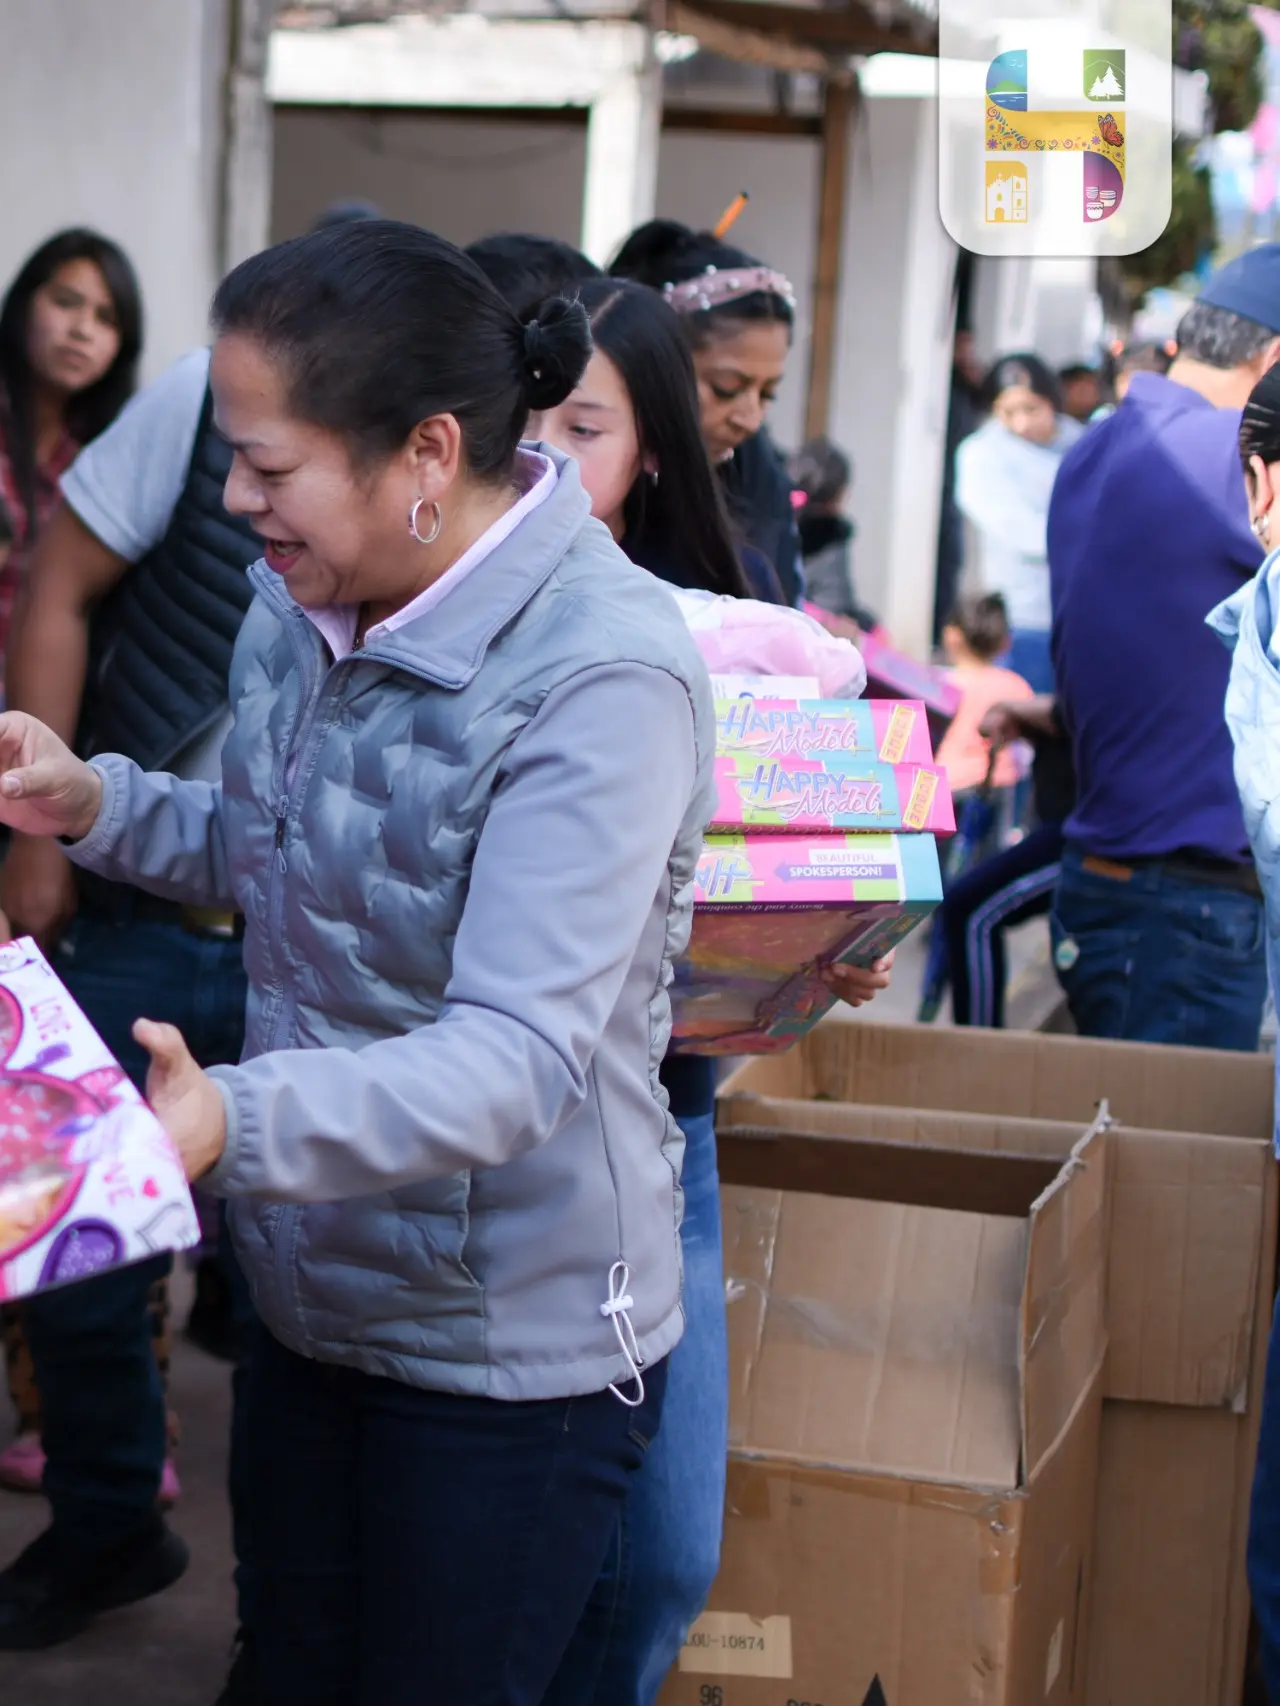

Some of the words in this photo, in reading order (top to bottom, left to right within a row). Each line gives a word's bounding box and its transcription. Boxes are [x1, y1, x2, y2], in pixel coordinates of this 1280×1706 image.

[717, 703, 821, 740] HAPPY
[762, 720, 857, 756] Model
[740, 763, 847, 800] HAPPY
[786, 783, 882, 819] Model
[789, 866, 882, 877] SPOKESPERSON!
[816, 853, 878, 863] BEAUTIFUL
[699, 1684, 723, 1706] 96
